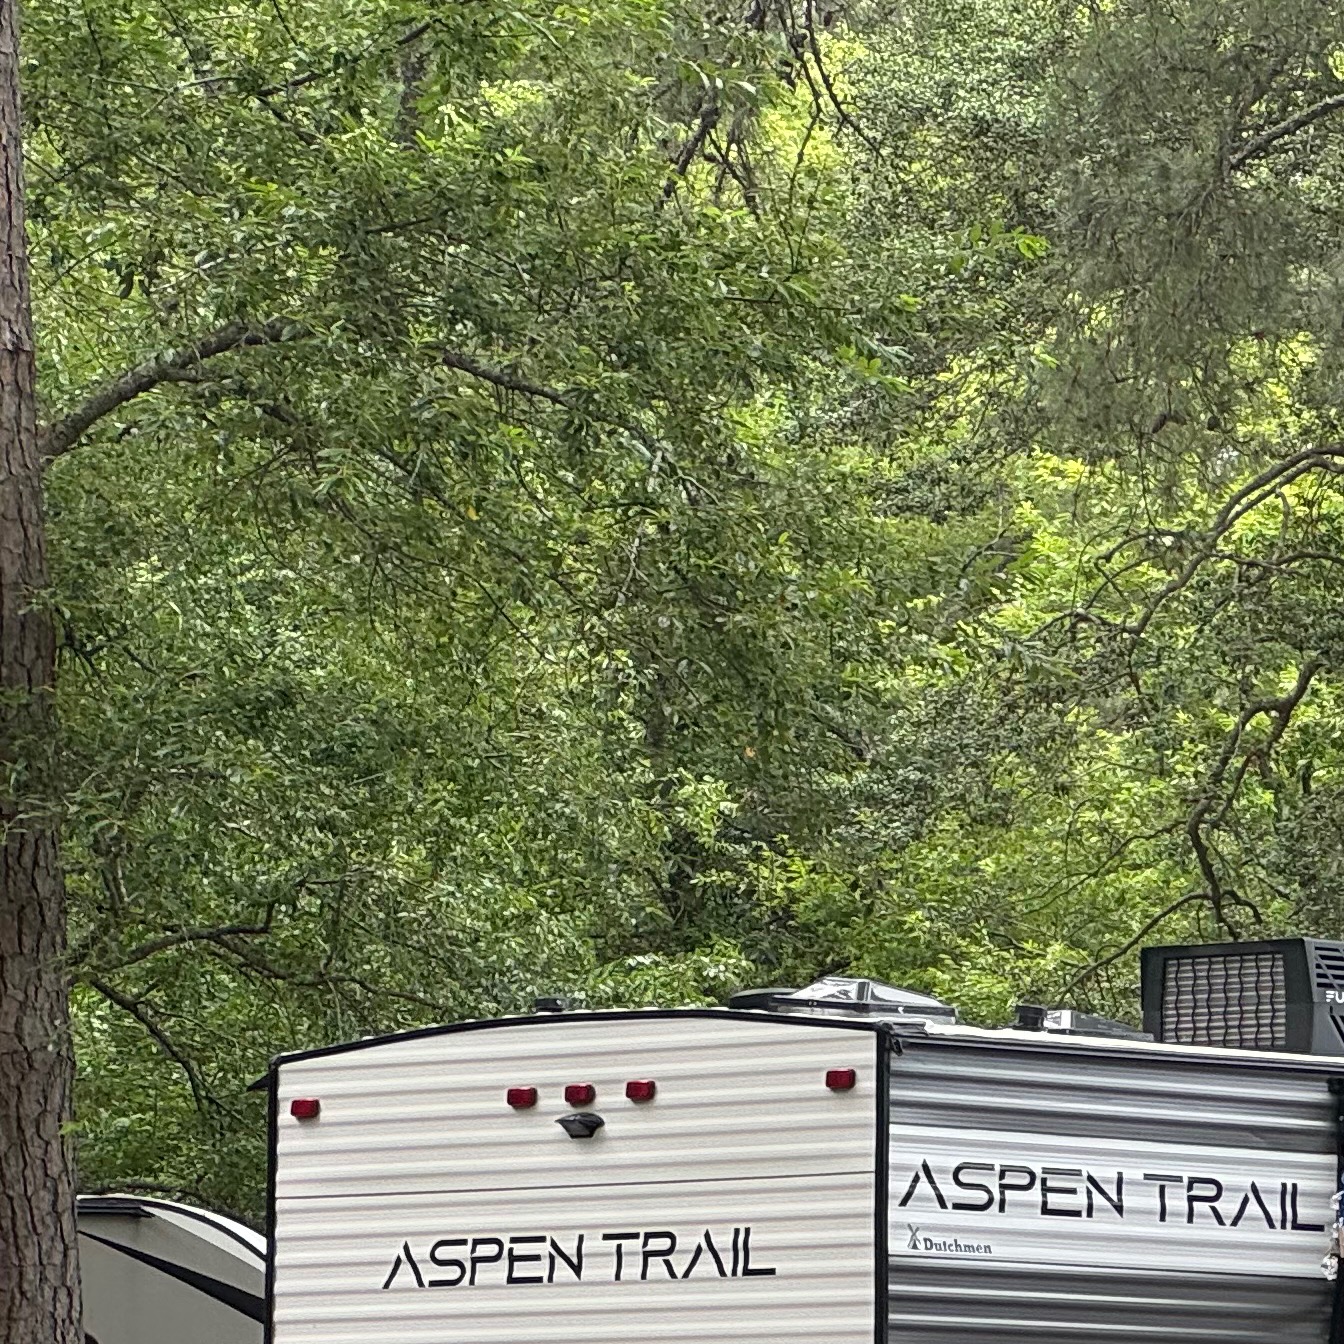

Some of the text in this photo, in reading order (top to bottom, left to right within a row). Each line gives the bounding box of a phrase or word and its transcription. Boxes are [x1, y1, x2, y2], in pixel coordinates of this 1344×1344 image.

[898, 1158, 1325, 1232] ASPEN TRAIL
[382, 1227, 777, 1290] ASPEN TRAIL
[923, 1237, 993, 1255] Dutchmen
